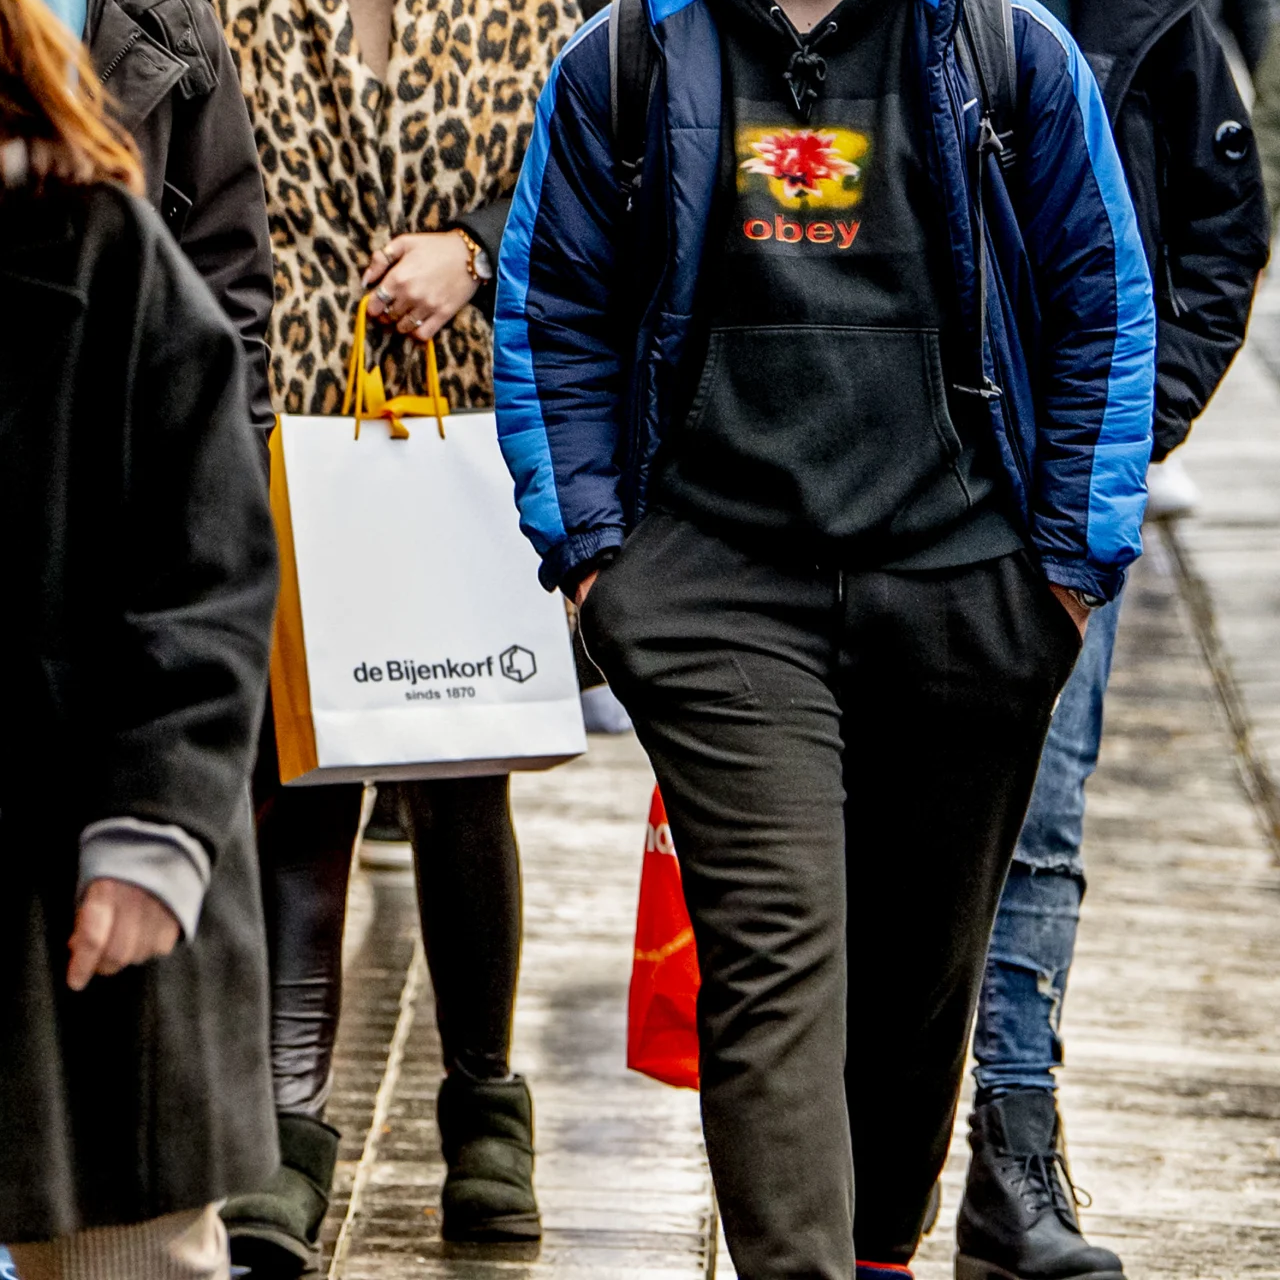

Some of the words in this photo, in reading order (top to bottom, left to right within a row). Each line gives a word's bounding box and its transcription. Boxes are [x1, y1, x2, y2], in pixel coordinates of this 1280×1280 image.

[743, 213, 860, 249] obey
[353, 662, 383, 683] de
[387, 656, 493, 686] Bijenkorf
[405, 689, 441, 701] sinds
[446, 687, 476, 700] 1870
